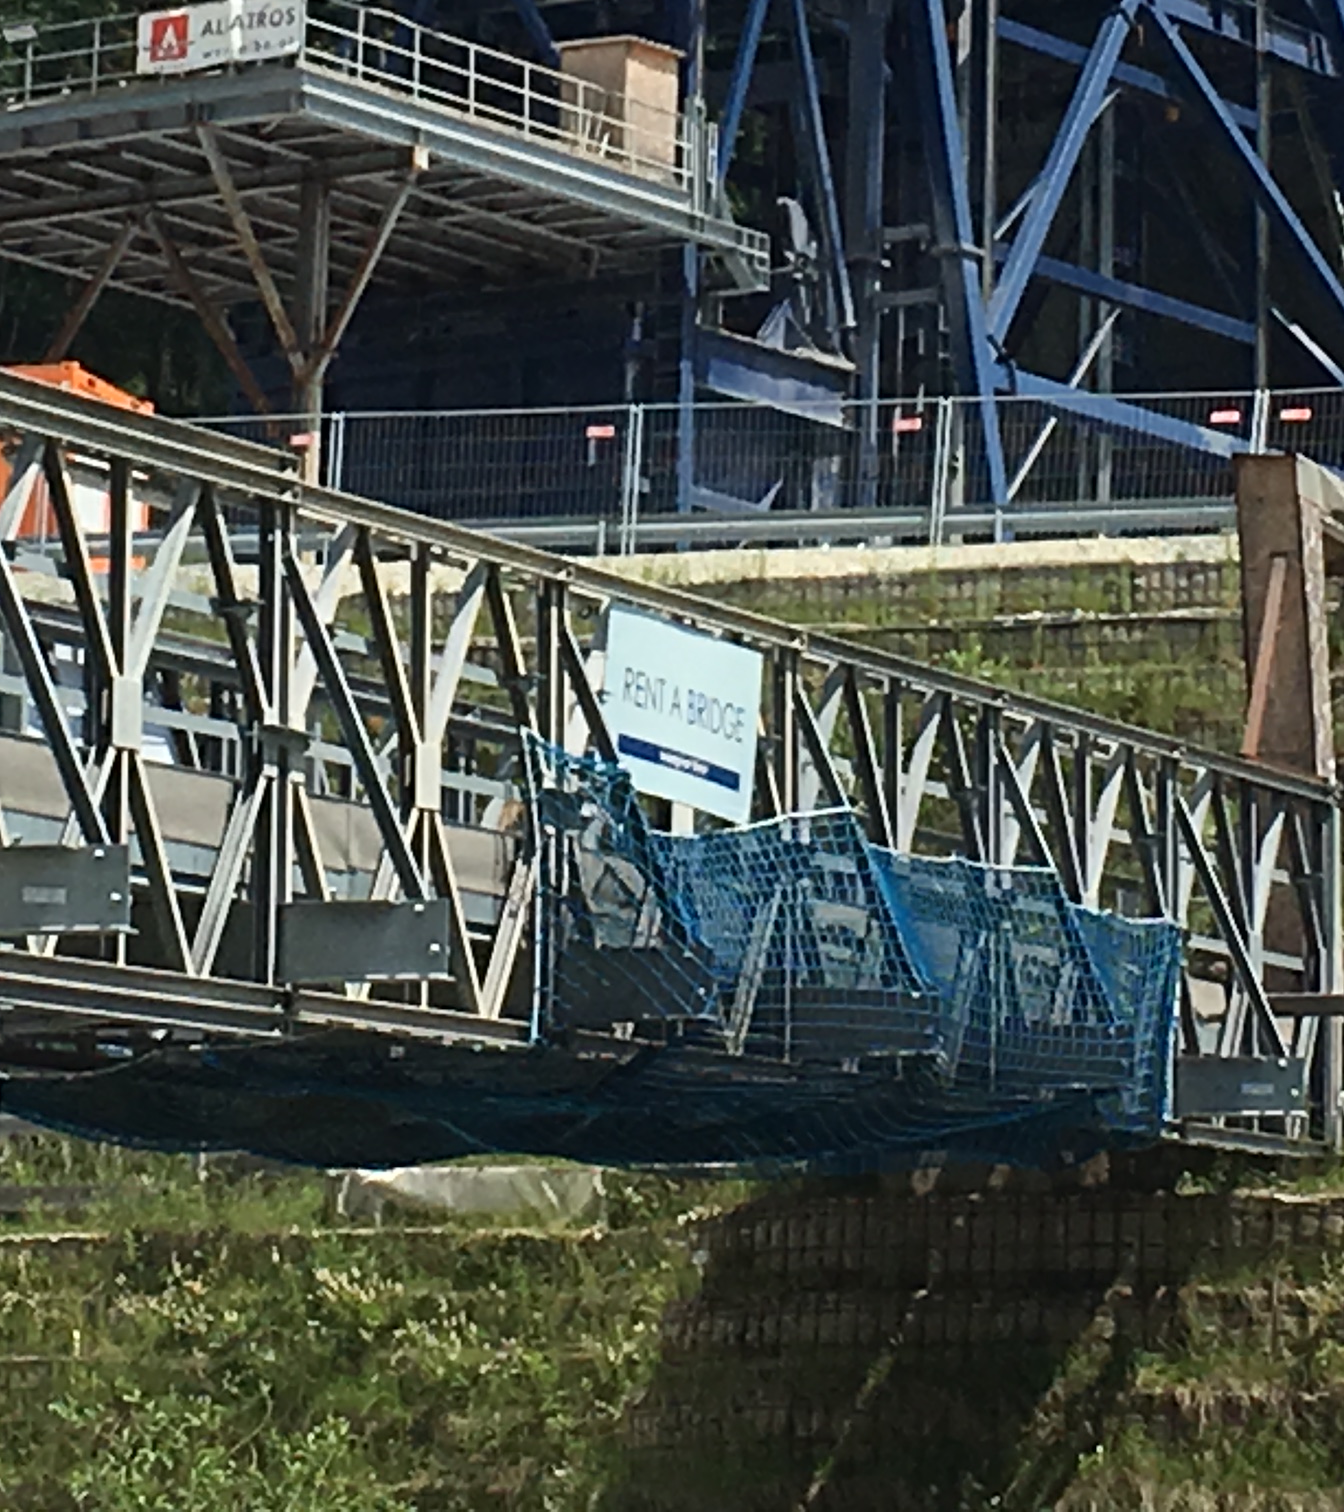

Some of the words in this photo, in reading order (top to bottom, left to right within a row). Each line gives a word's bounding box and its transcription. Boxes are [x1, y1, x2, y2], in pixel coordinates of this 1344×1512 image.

[622, 666, 668, 714] RENT
[668, 684, 683, 721] A
[686, 688, 746, 743] BRIDGE
